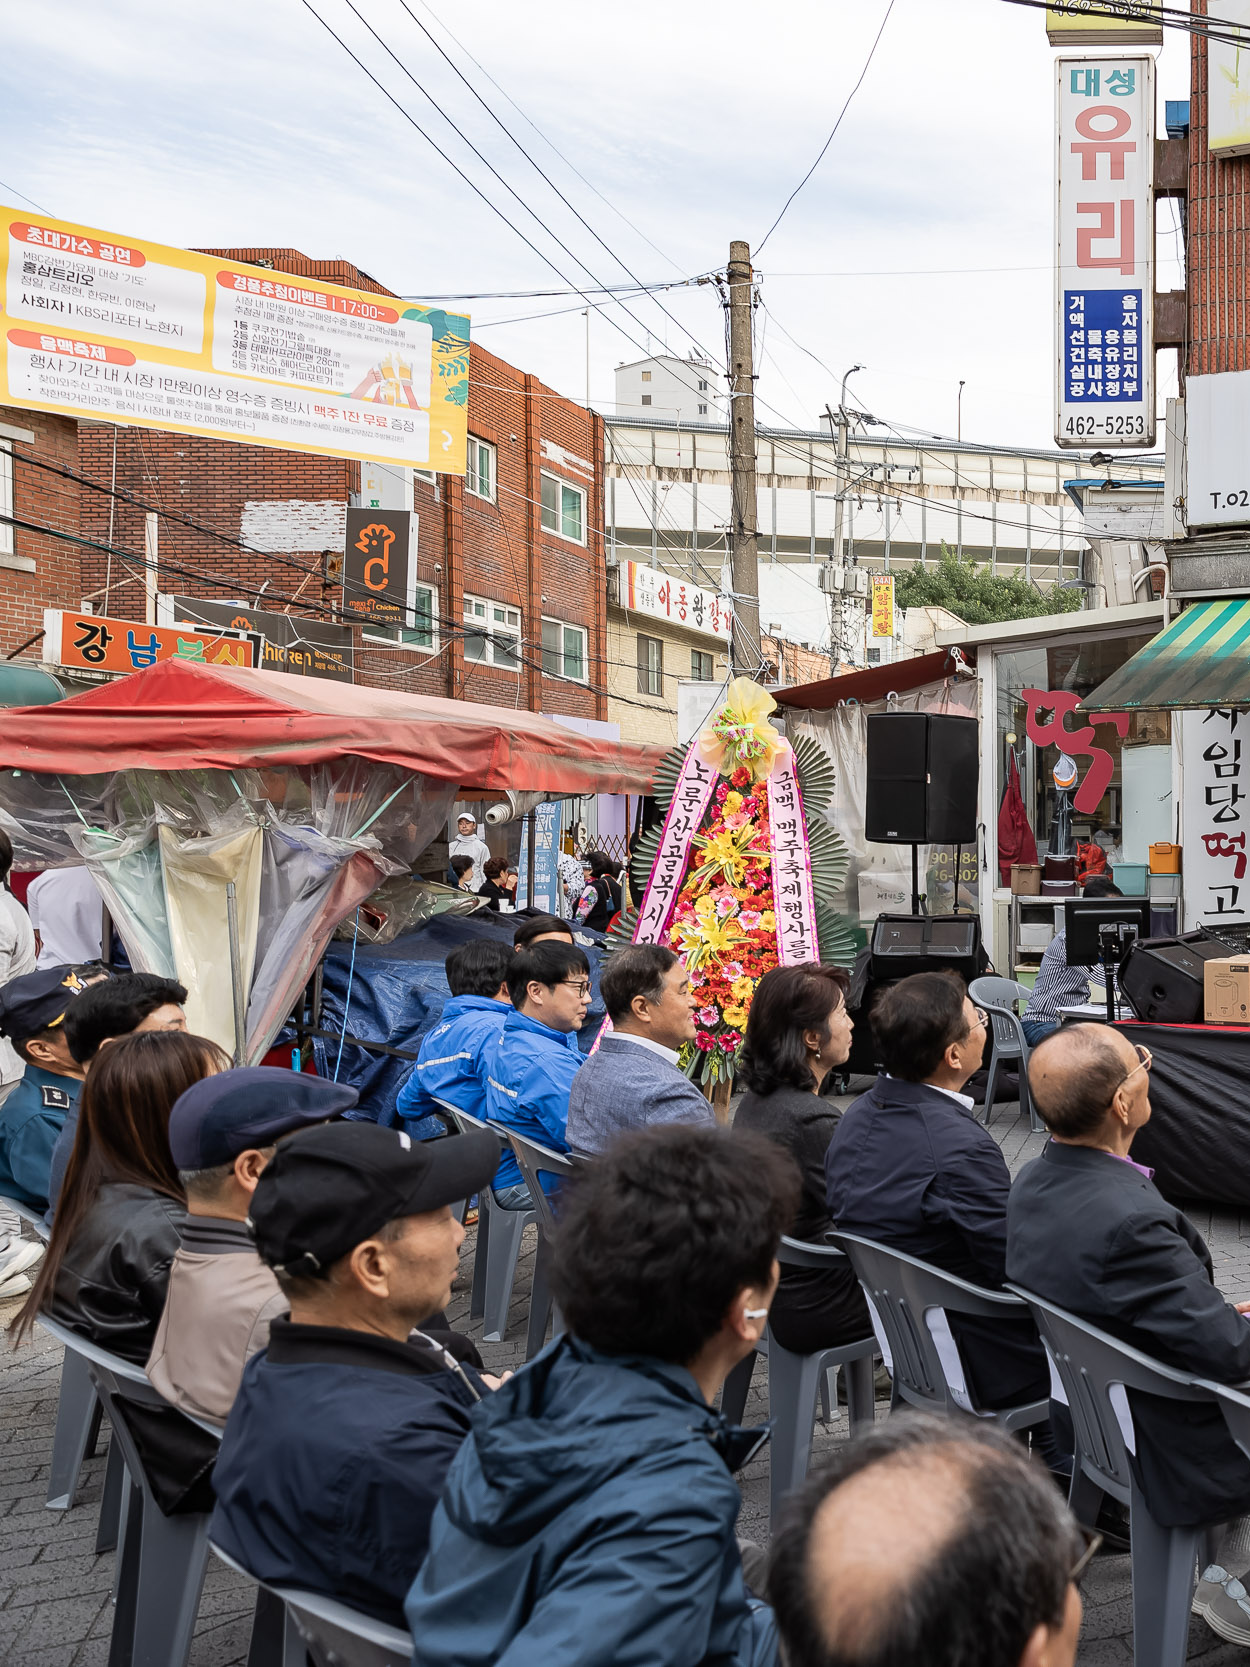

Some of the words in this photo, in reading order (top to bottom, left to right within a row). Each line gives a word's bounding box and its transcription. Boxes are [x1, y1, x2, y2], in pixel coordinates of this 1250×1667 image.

[1070, 68, 1136, 97] 대성
[1070, 105, 1136, 276] 유리
[27, 227, 94, 255] 초대가수
[99, 243, 131, 264] 공연
[22, 261, 94, 287] 홍삼트리오
[99, 268, 119, 280] 대상
[232, 275, 328, 307] 경품추첨이벤트
[340, 300, 385, 320] 17:00~
[21, 293, 64, 313] 사회자
[76, 305, 141, 329] KBS리포터
[145, 318, 184, 336] 노현지
[235, 296, 253, 307] 시장
[255, 300, 265, 310] 내
[266, 302, 286, 315] 1만원
[288, 307, 306, 319] 이상
[307, 310, 348, 327] 구매영수증
[277, 313, 294, 325] 증정
[233, 320, 248, 331] 1등
[233, 330, 248, 341] 2등
[1069, 329, 1138, 345] 선물용품
[40, 335, 107, 361] 음맥축제
[232, 340, 248, 350] 3등
[316, 355, 340, 369] 28cm
[232, 350, 247, 361] 4등
[250, 352, 277, 366] 유닉스
[1069, 347, 1138, 362] 건축유리
[232, 359, 247, 371] 5등
[1069, 364, 1138, 379] 실내장치
[30, 354, 63, 372] 행사
[68, 361, 100, 379] 기간
[104, 368, 118, 382] 내
[124, 371, 154, 389] 시장
[158, 377, 222, 400] 1만원이상
[226, 389, 267, 408] 영수증
[271, 397, 310, 416] 증빙시
[314, 404, 339, 420] 맥주
[343, 410, 360, 423] 1잔
[363, 413, 388, 428] 무료
[391, 418, 414, 433] 증정
[1069, 381, 1138, 397] 공사청부
[1065, 416, 1144, 436] 462-5253
[874, 577, 890, 585] 24시
[262, 642, 312, 667] hicken
[1021, 689, 1130, 814] 떡
[1201, 831, 1248, 879] 떡
